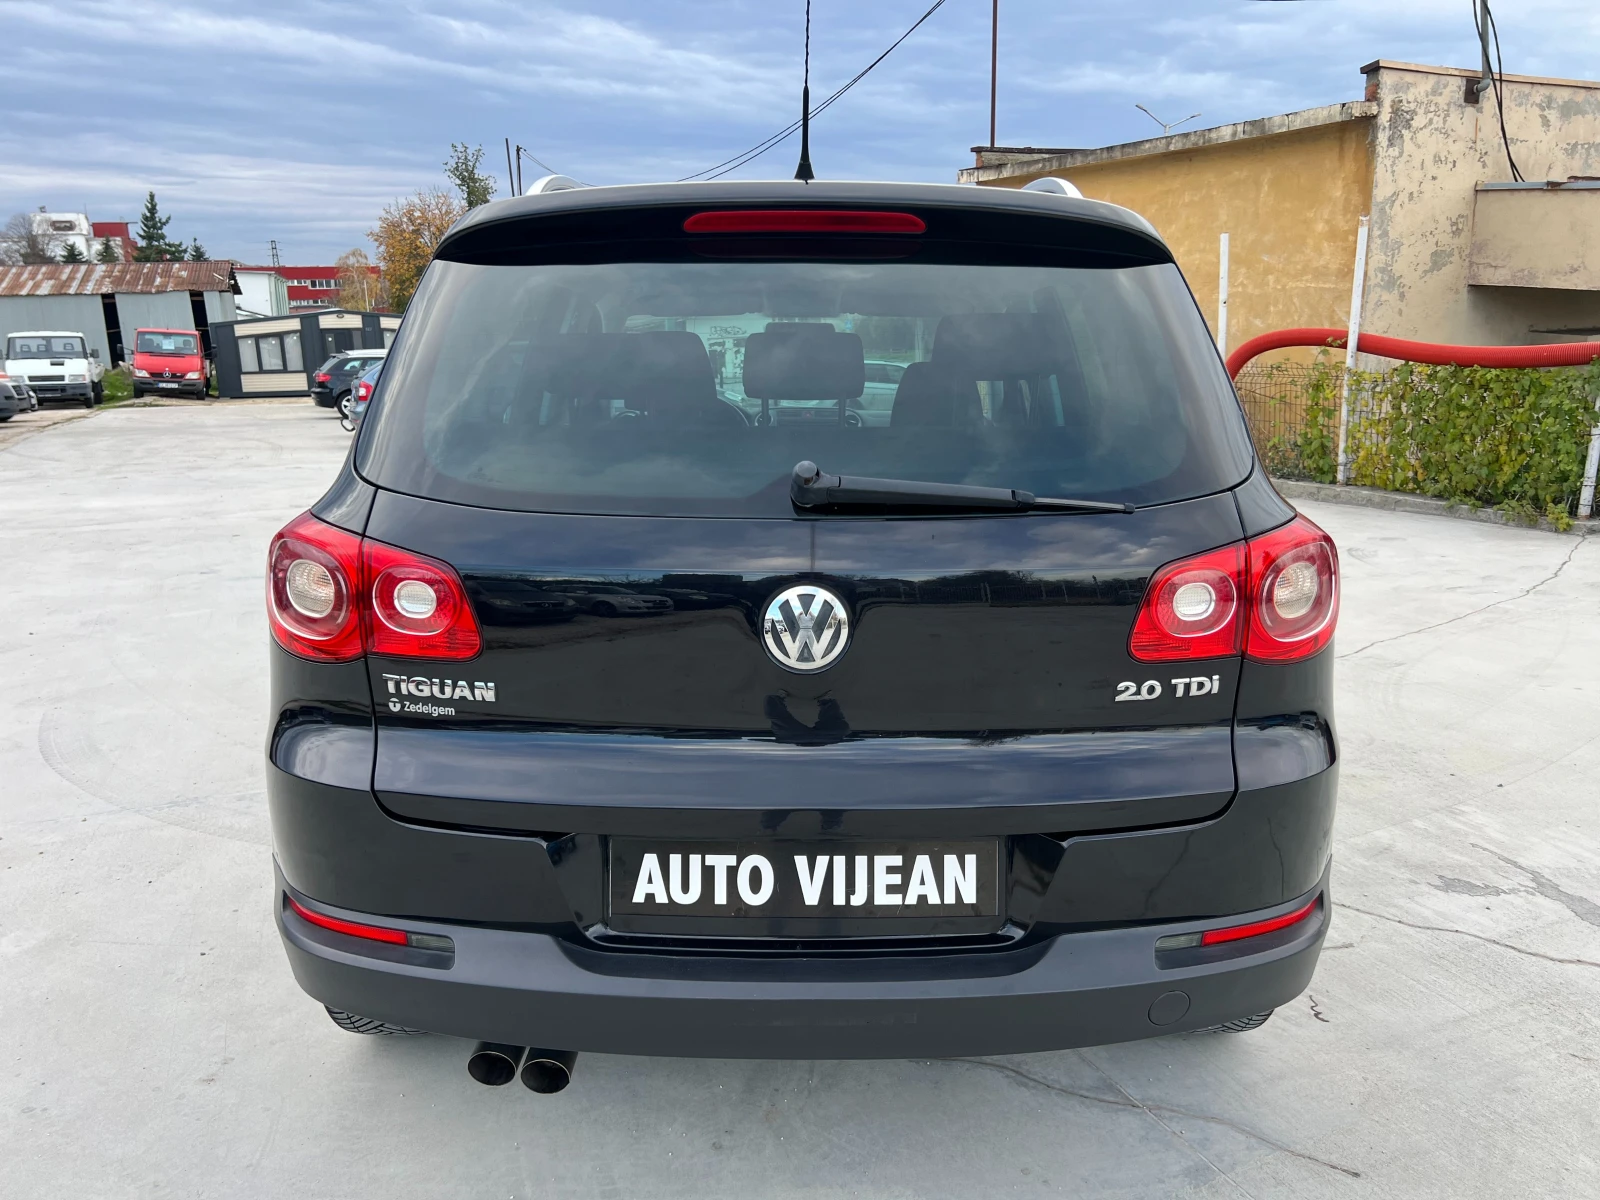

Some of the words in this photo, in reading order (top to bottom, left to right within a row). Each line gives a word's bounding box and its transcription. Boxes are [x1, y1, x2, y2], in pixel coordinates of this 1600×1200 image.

[764, 585, 849, 670] VW
[382, 673, 496, 702] TIGUAN
[403, 701, 456, 717] Zedelgem
[631, 853, 775, 906] AUTO
[794, 854, 977, 907] VIJEAN
